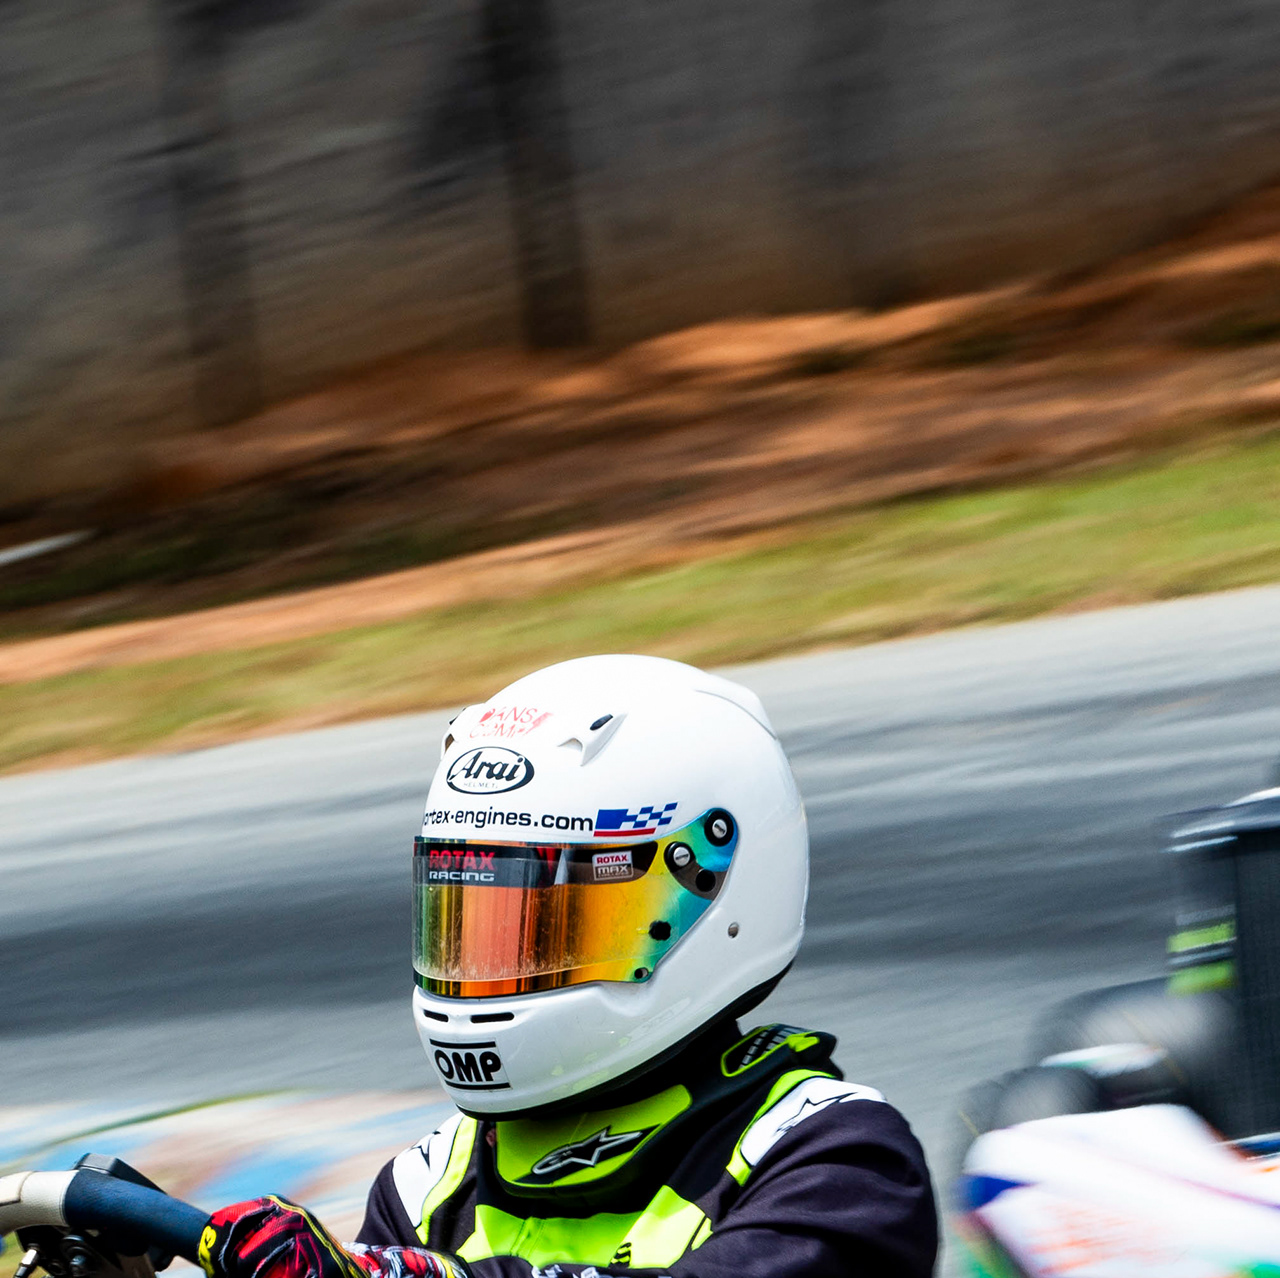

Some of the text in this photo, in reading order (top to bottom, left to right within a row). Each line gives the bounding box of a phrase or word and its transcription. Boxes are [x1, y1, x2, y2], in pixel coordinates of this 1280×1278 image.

[449, 751, 524, 781] Arai
[429, 850, 495, 870] ROTAX
[596, 854, 627, 864] ROTAX
[429, 871, 495, 881] RACING
[434, 1051, 501, 1082] OMP
